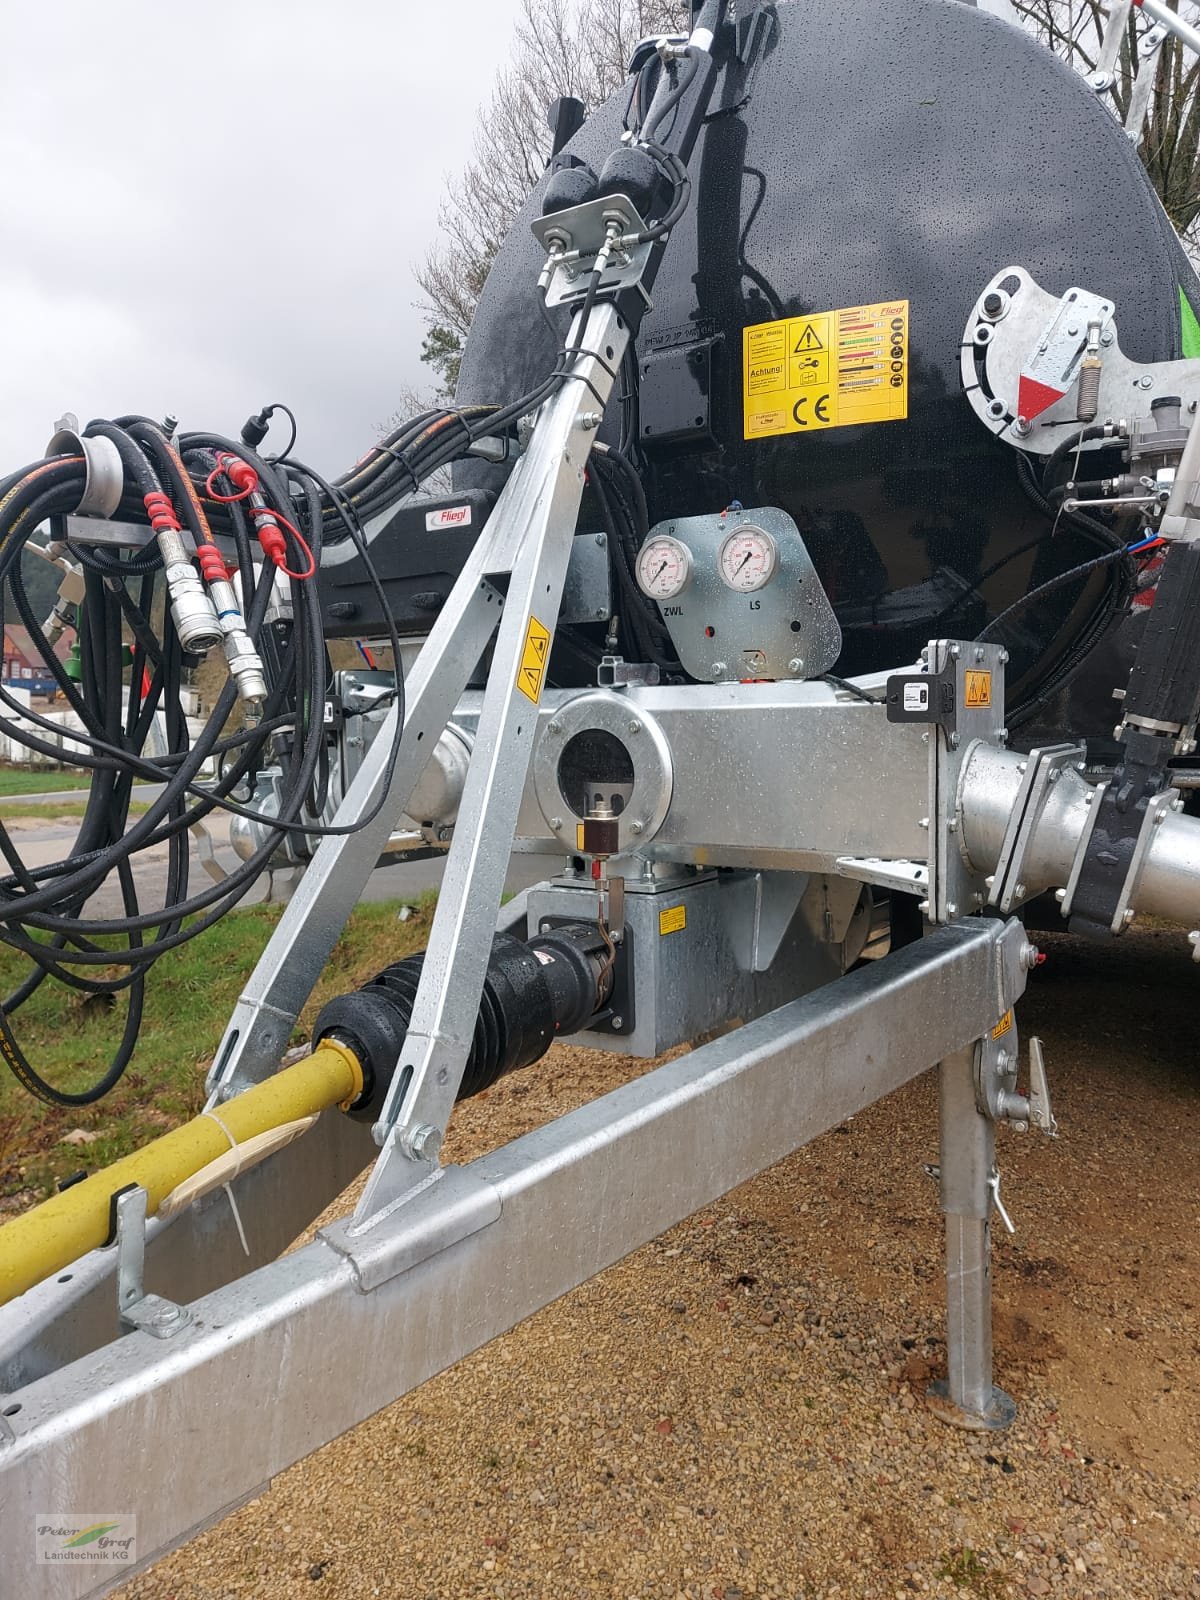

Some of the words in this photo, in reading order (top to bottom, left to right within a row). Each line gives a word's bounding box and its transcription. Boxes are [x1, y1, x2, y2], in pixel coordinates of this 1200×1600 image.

[880, 305, 905, 317] Fliegl
[750, 365, 783, 377] Achtung!
[441, 508, 466, 522] Fliegl
[750, 600, 761, 610] LS
[664, 607, 684, 617] ZWL
